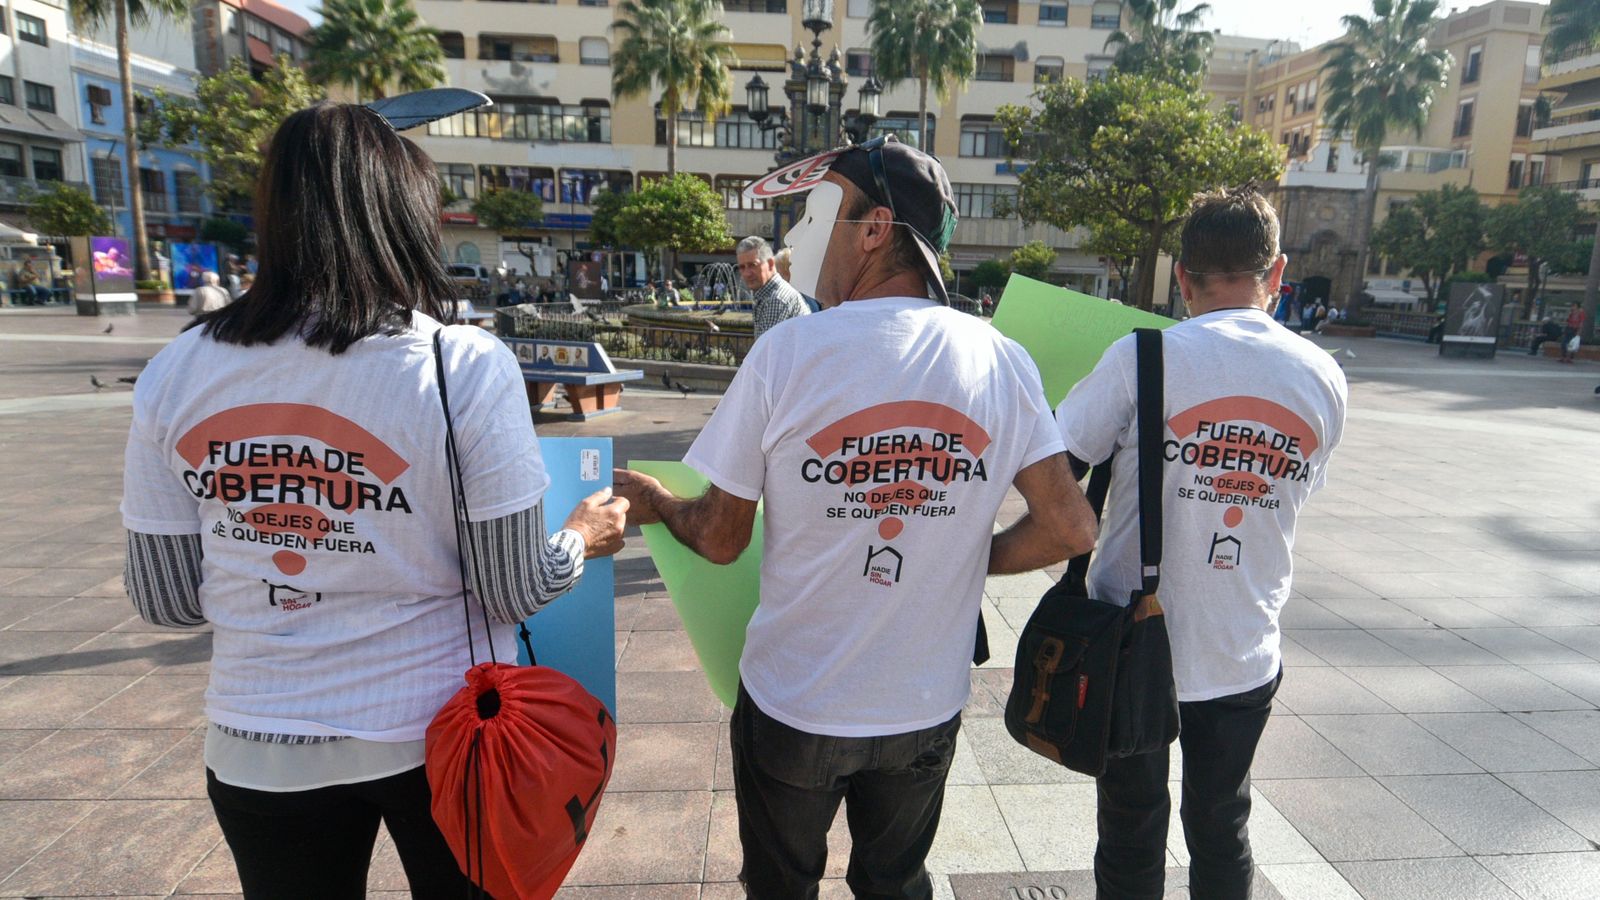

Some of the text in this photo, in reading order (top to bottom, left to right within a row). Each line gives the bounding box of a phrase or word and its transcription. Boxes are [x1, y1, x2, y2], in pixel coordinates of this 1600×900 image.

[841, 433, 963, 456] FUERA DE
[1196, 420, 1301, 455] FUERA DE
[208, 440, 365, 476] FUERA DE
[1162, 439, 1310, 482] COBERTURA
[801, 457, 988, 485] COBERTURA
[1194, 474, 1214, 486] NO
[1217, 478, 1255, 492] DEJES
[183, 469, 413, 514] COBERTURA
[844, 488, 948, 504] NO DEJES QUE
[1177, 487, 1195, 500] SE
[1198, 490, 1249, 506] QUEDEN
[226, 507, 355, 534] NO DEJES QUE
[826, 507, 846, 518] SE
[913, 504, 956, 517] FUERA
[212, 521, 376, 554] SE QUEDEN FUERA
[869, 578, 892, 588] HOGAR
[871, 566, 891, 575] NADIE
